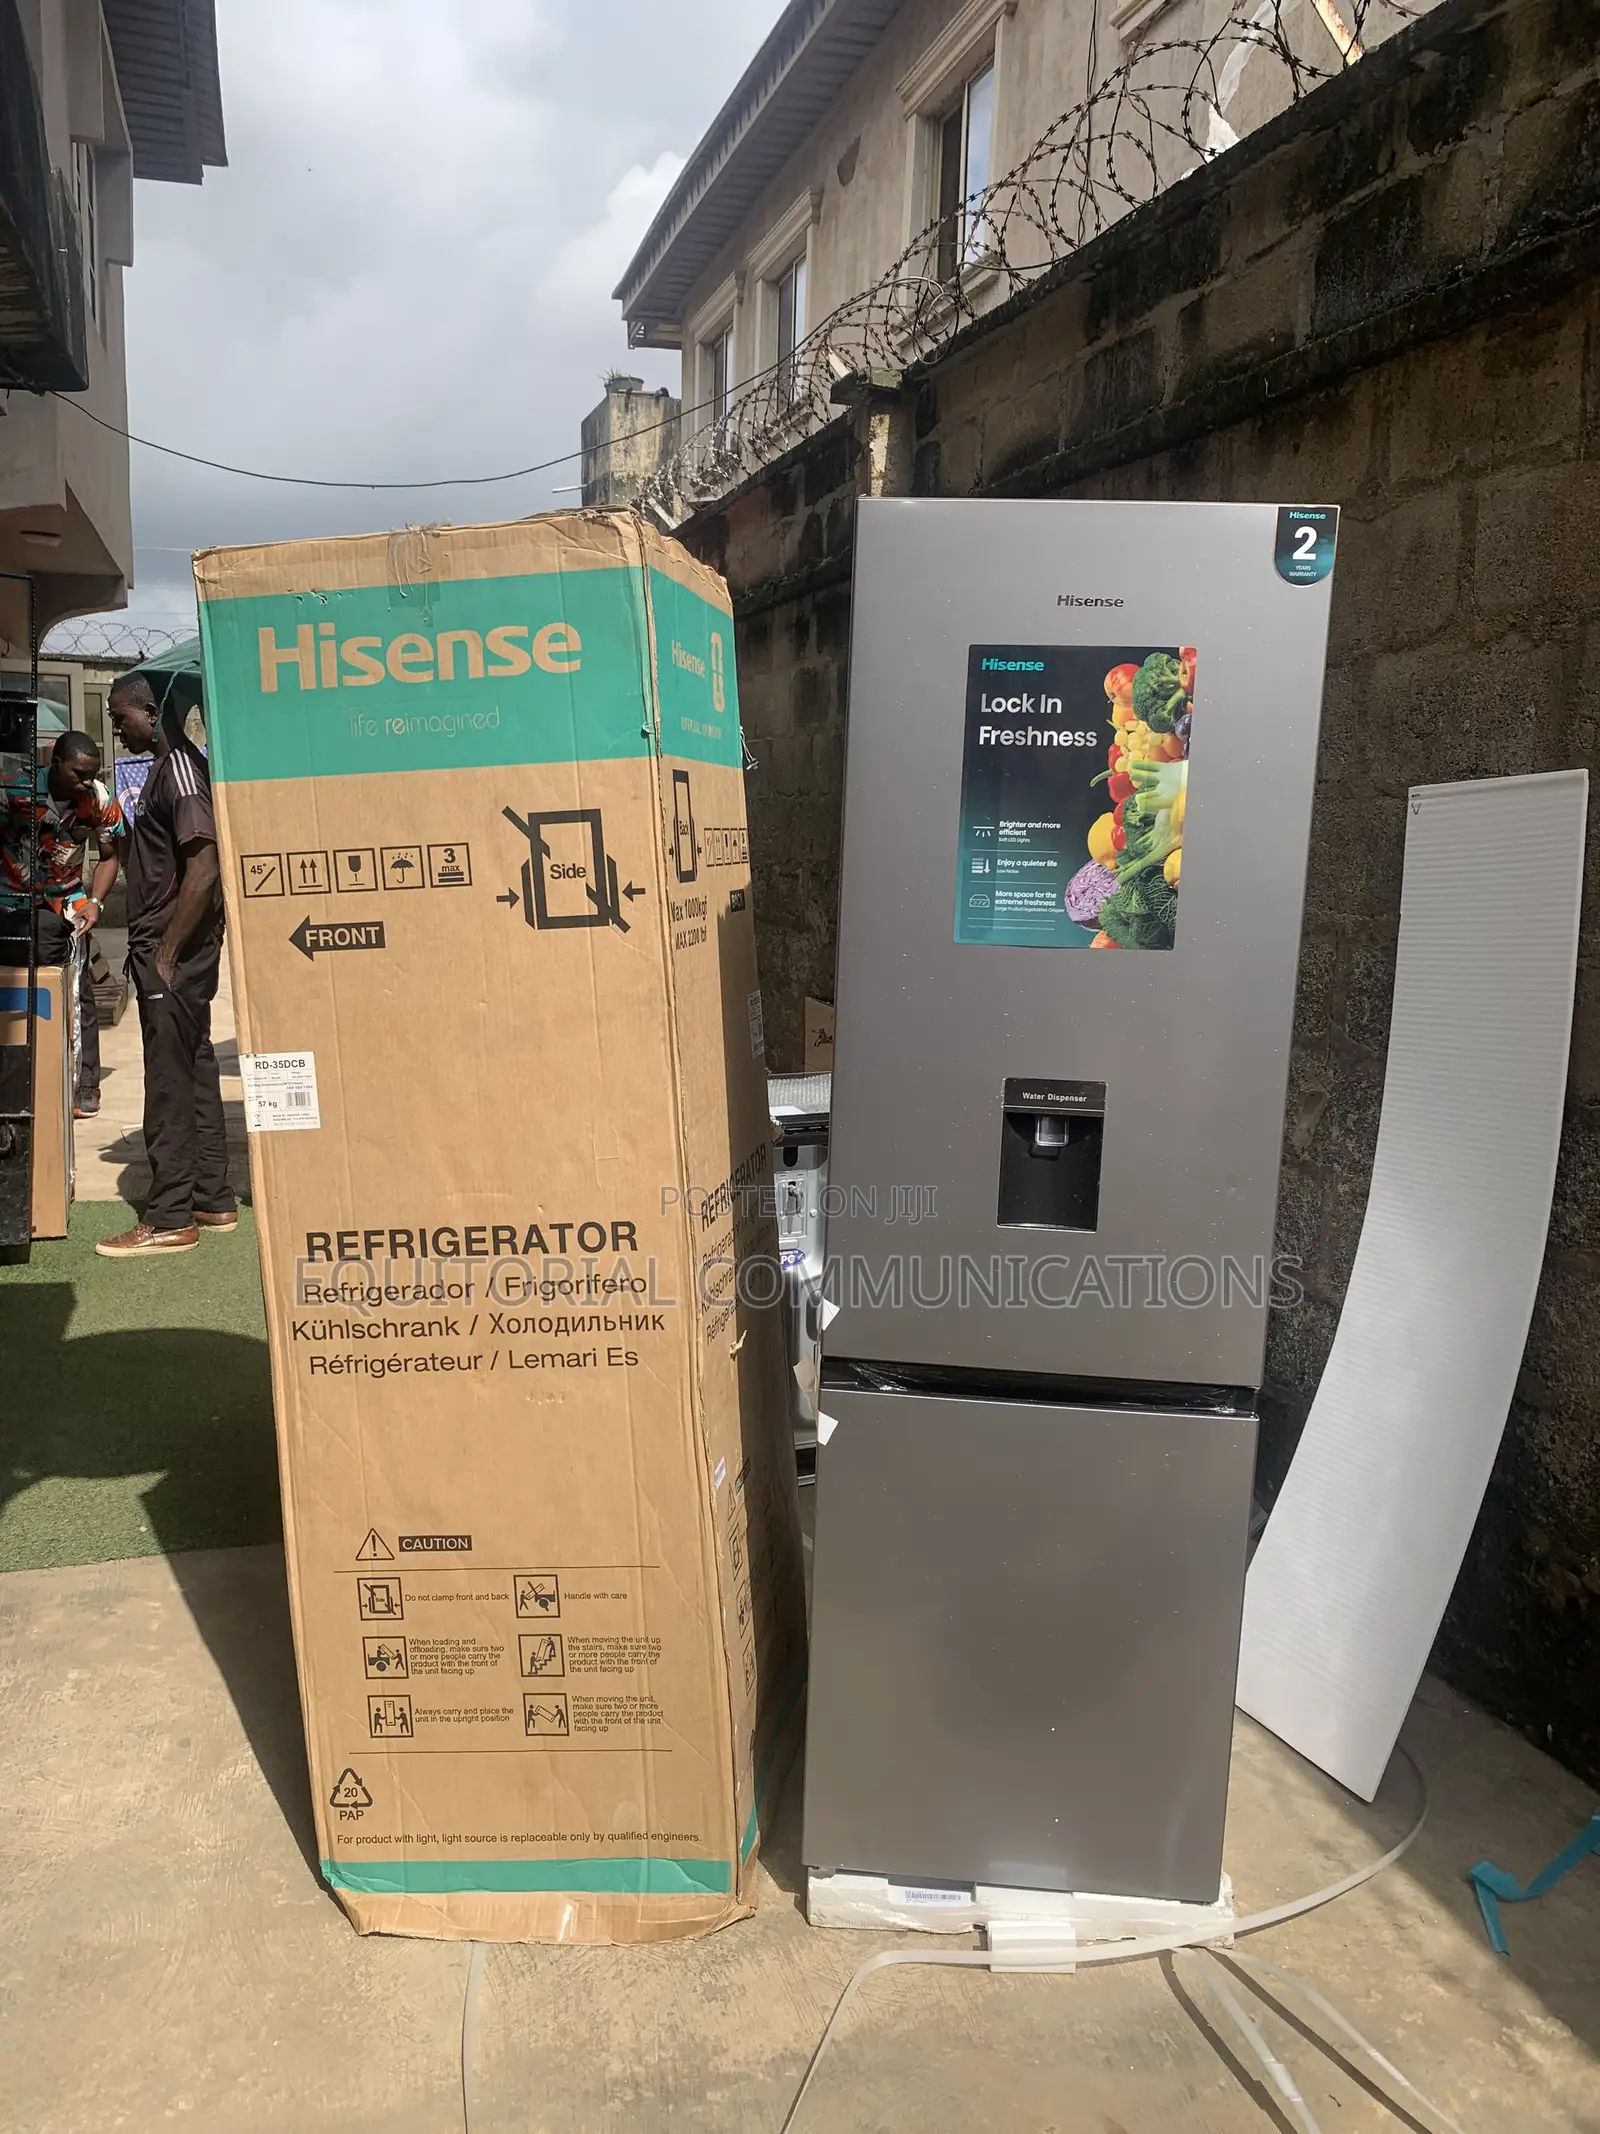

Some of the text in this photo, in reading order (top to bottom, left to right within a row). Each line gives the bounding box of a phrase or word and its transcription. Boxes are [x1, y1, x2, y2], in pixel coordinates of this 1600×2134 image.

[1289, 511, 1326, 520] Hisense
[1292, 526, 1317, 560] 2
[1056, 594, 1124, 609] Hisense
[259, 621, 582, 693] Hisense
[671, 639, 706, 679] Hisense
[981, 658, 1045, 671] Hisense
[981, 693, 1062, 714] Lock In
[350, 705, 500, 738] life reimagined
[979, 726, 1098, 747] Freshness
[1000, 821, 1027, 829] Brighter
[443, 848, 457, 864] 3
[997, 859, 1015, 867] Enjoy
[441, 865, 460, 873] max
[550, 863, 586, 879] Side
[305, 926, 380, 947] FRONT
[255, 1059, 306, 1070] RD-35DCB
[1022, 1091, 1087, 1102] Water Dispenser
[268, 1100, 278, 1108] kg
[306, 1221, 638, 1262] REFRIGERATOR
[304, 1279, 475, 1307] Refrigerador
[292, 1312, 665, 1341] Kühlschrank Холодильник
[310, 1347, 639, 1378] Réfrigérateur Lemari Es
[402, 1537, 469, 1550] CAUTION
[432, 1594, 454, 1602] clamp
[564, 1592, 591, 1600] Handle
[432, 1638, 460, 1647] loading
[592, 1637, 619, 1645] moving
[441, 1653, 466, 1662] people
[569, 1658, 598, 1667] product
[411, 1661, 438, 1669] product
[600, 1665, 622, 1674] facing
[440, 1667, 463, 1676] facing
[596, 1696, 623, 1704] moving
[415, 1708, 441, 1716] Always
[480, 1708, 500, 1716] place
[573, 1711, 598, 1719] people
[636, 1710, 664, 1718] product
[453, 1715, 479, 1723] upright
[481, 1715, 510, 1723] position
[344, 1787, 358, 1798] 20
[339, 1810, 364, 1821] PAP
[337, 1835, 353, 1844] For
[356, 1834, 392, 1845] product
[394, 1834, 413, 1843] with
[416, 1834, 439, 1844] light,
[442, 1833, 462, 1843] light
[500, 1834, 508, 1842] is
[510, 1833, 567, 1844] replaceable
[570, 1833, 590, 1843] only
[593, 1832, 605, 1843] by
[607, 1832, 648, 1843] qualified
[651, 1832, 701, 1843] engineers.
